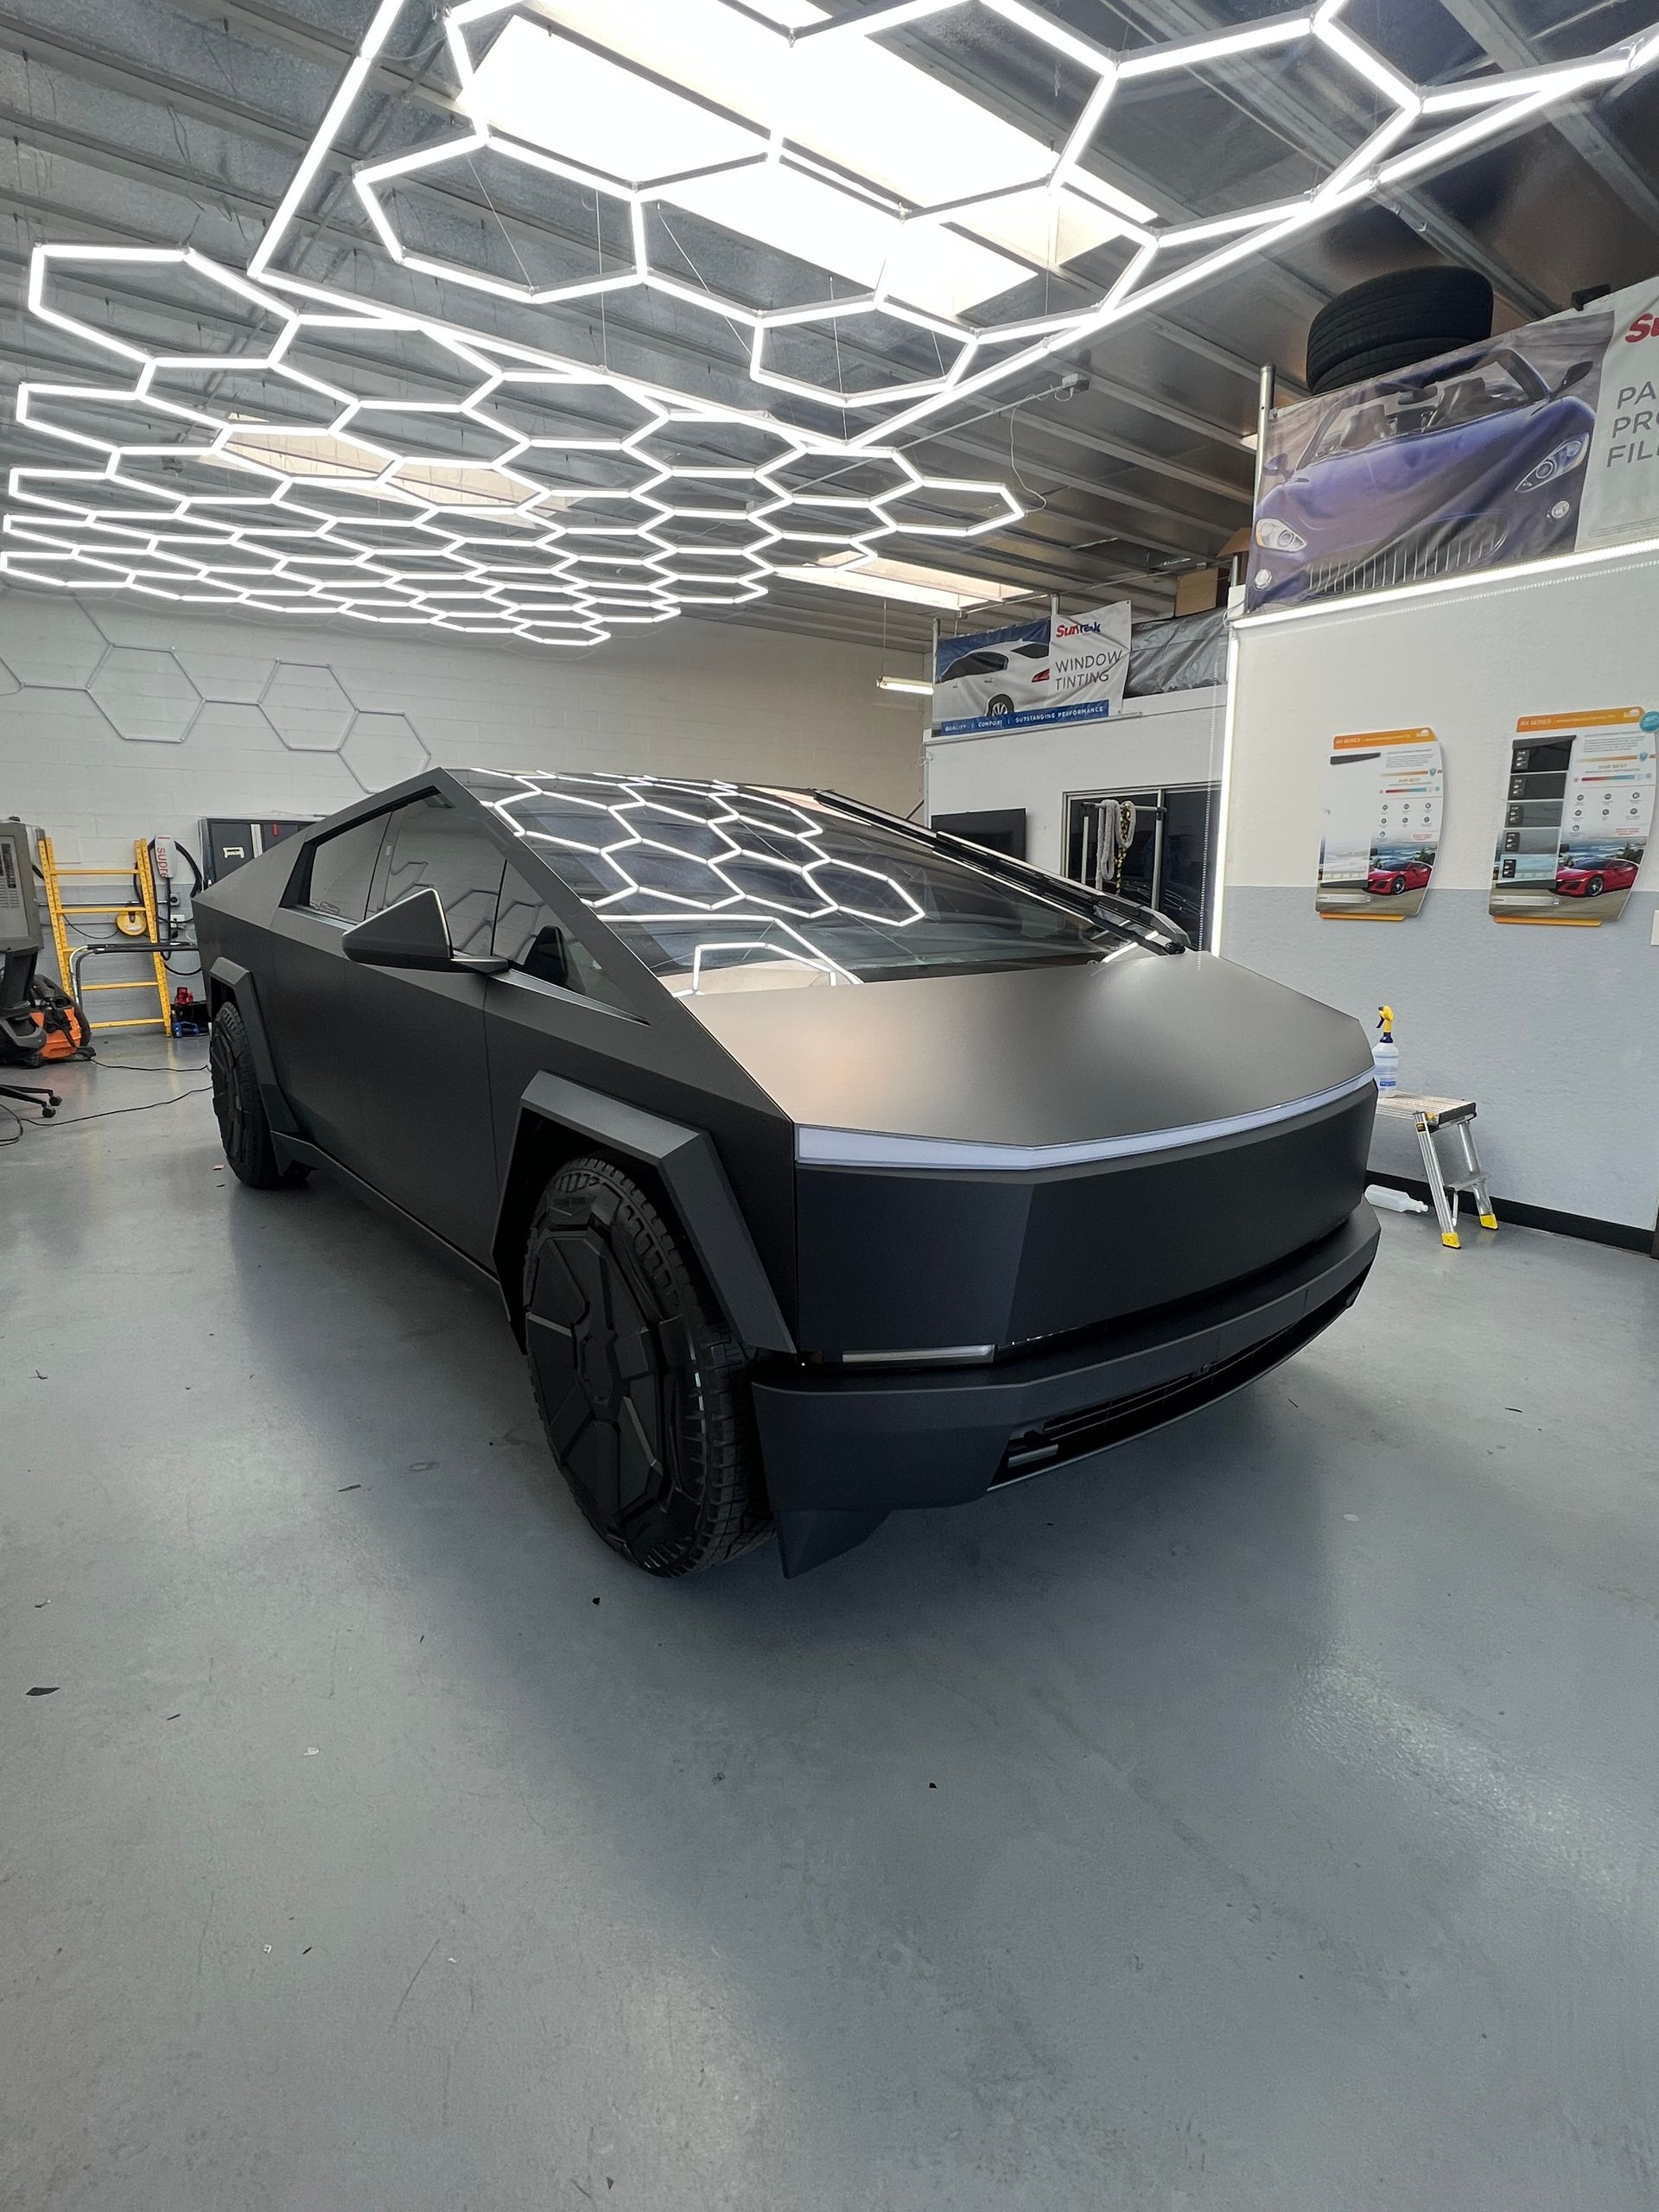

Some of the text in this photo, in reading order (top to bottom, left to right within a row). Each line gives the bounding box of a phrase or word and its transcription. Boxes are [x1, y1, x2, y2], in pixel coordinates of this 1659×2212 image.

[1617, 380, 1656, 410] PA
[1611, 410, 1659, 439] PR
[1606, 440, 1659, 468] FIL
[1056, 621, 1102, 639] SunTek
[1055, 649, 1123, 673] WINDOW
[1055, 671, 1109, 690] TINTING
[1014, 712, 1056, 723] OUTSTANDING
[1057, 706, 1104, 718] PERFORMANCE
